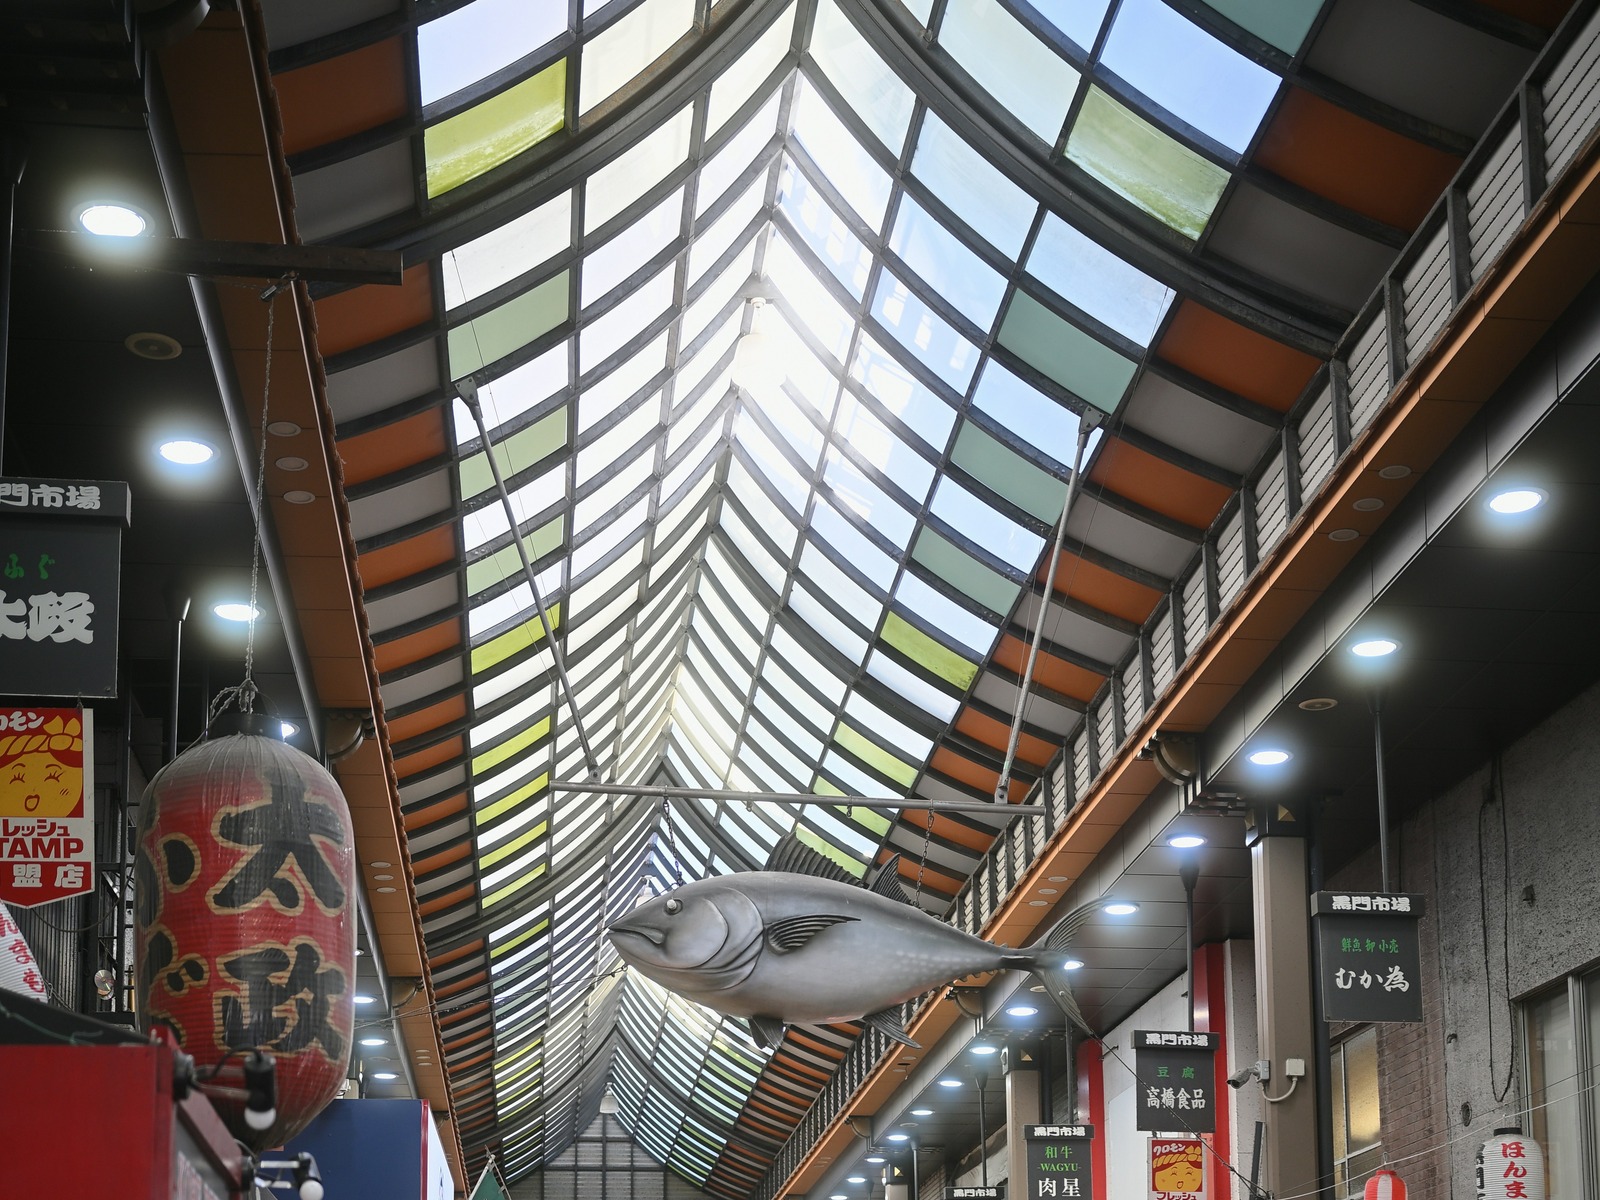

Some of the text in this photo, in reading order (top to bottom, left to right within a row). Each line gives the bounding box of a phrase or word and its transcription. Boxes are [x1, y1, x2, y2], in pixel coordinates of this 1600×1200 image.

[1332, 895, 1411, 912] 黒門市場
[1145, 1033, 1209, 1047] 黒門市場
[1156, 1066, 1195, 1079] 豆腐
[1146, 1086, 1206, 1110] 高橋食品
[1034, 1127, 1086, 1137] 黒門市場
[1045, 1145, 1073, 1159] 和牛
[1153, 1142, 1186, 1157] クロモン
[1038, 1177, 1081, 1198] 肉星
[1156, 1191, 1197, 1200] フレッシュ
